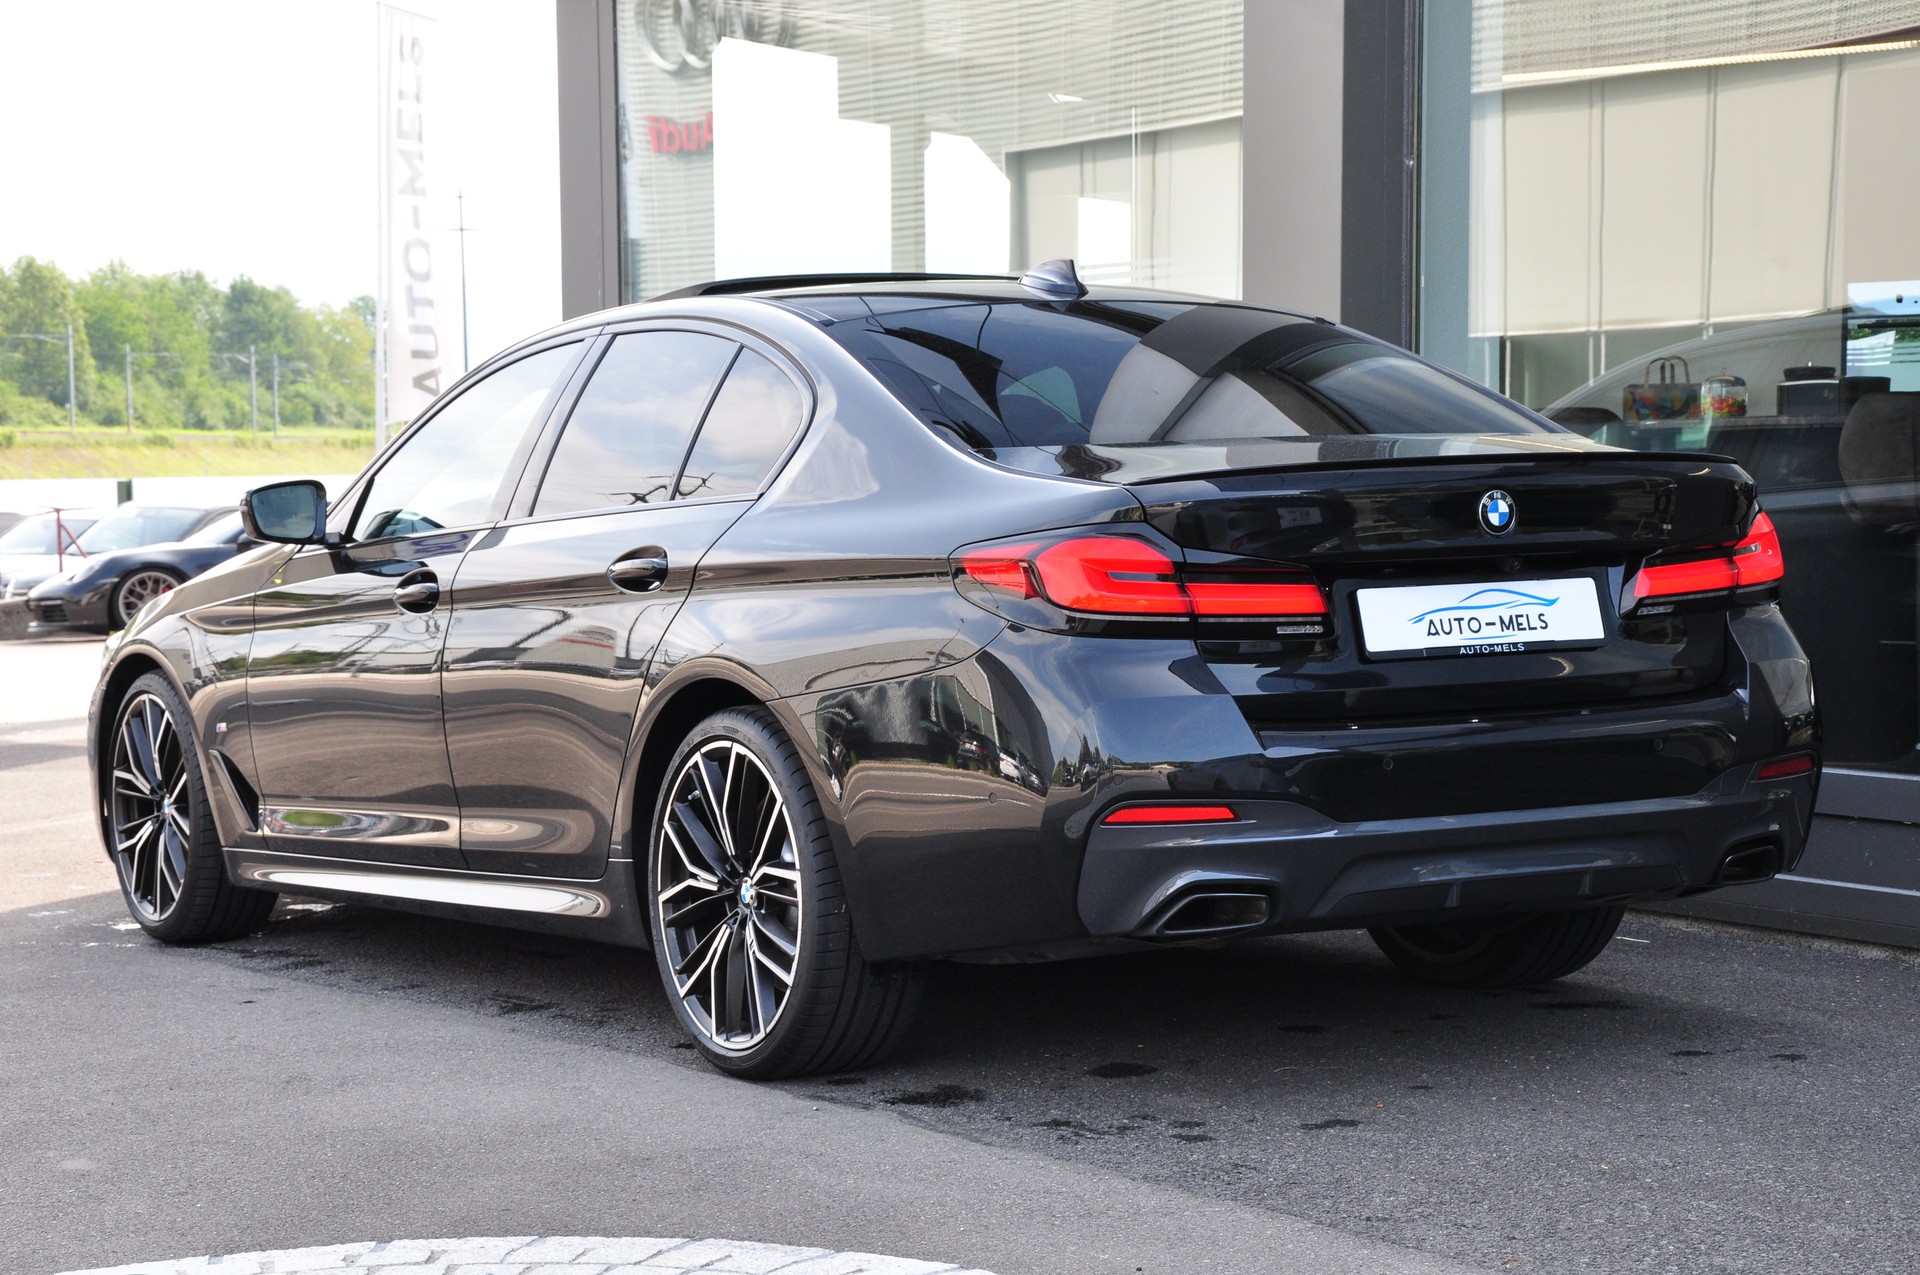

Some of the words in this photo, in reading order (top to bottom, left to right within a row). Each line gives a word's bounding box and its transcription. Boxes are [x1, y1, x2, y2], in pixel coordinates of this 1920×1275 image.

[397, 33, 442, 398] AUTO-MELS
[1426, 613, 1549, 637] AUTO-MELS
[1459, 642, 1525, 655] AUTO-MELS
